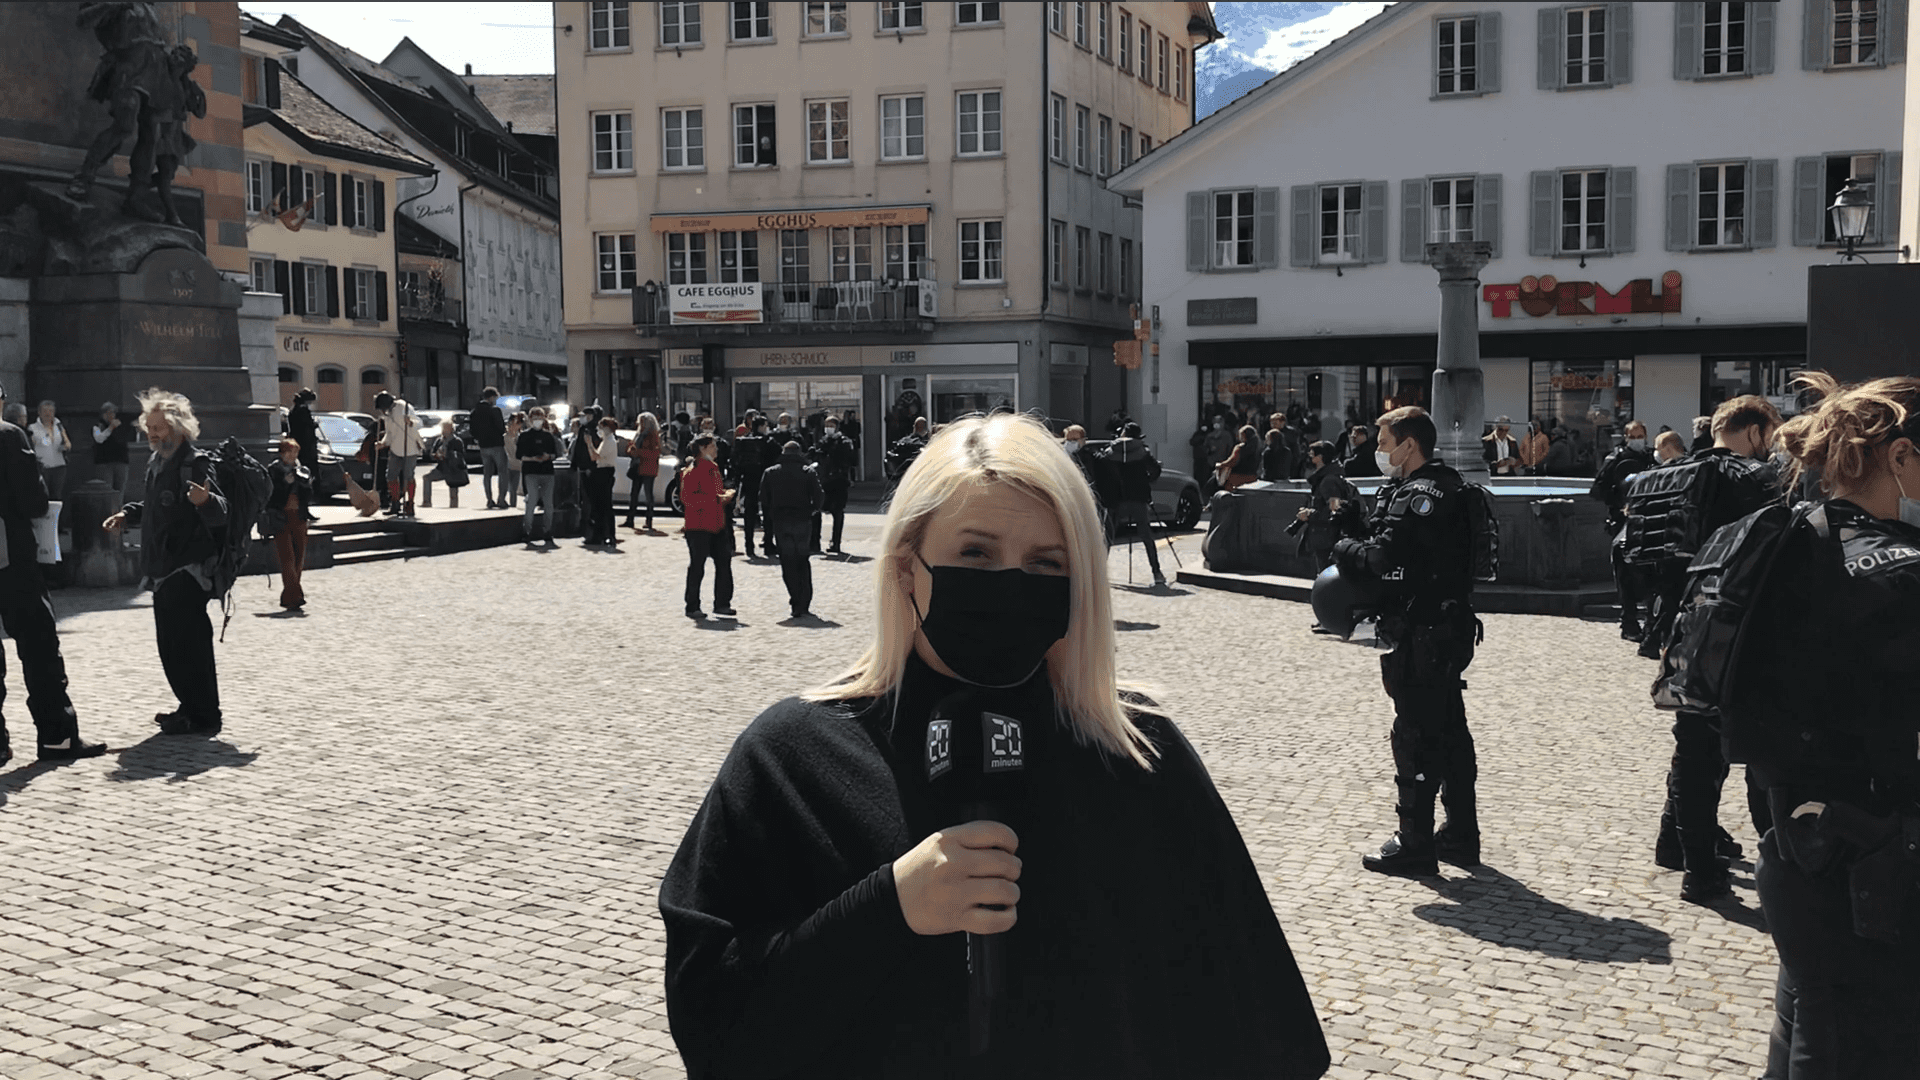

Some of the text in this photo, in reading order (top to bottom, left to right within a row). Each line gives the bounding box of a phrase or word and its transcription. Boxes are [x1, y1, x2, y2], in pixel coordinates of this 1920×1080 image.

[757, 214, 817, 227] EGGHUS
[172, 288, 194, 299] 1307
[677, 285, 755, 297] CAFE EGGHUS
[139, 321, 195, 337] WILHELM
[283, 336, 310, 352] Cafe
[760, 352, 829, 366] UHREN-SCHMUCK
[1412, 483, 1444, 499] POLIZEI
[929, 724, 949, 763] 20
[991, 718, 1022, 756] 20
[991, 758, 1023, 768] minuten
